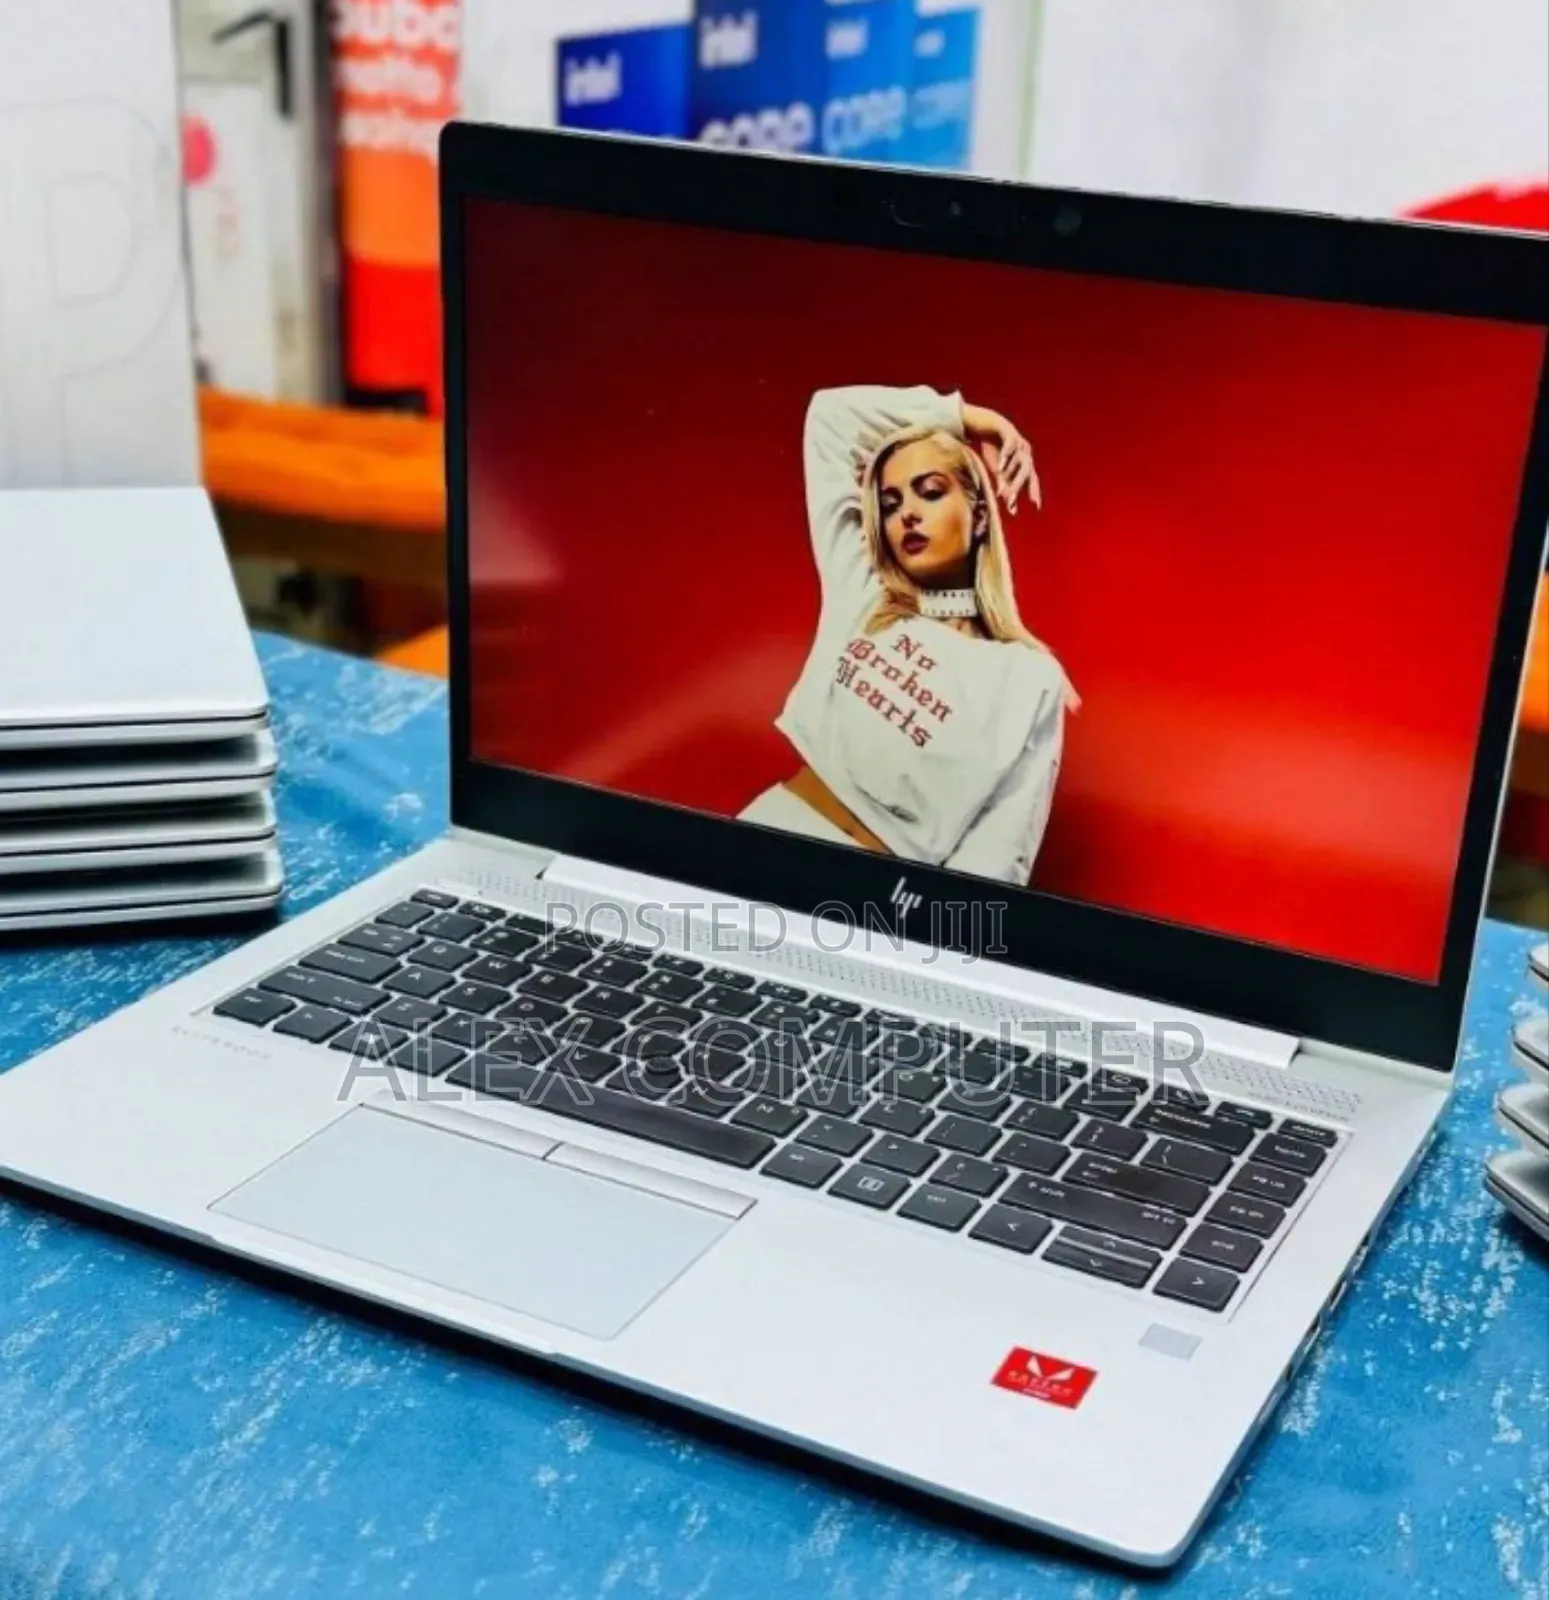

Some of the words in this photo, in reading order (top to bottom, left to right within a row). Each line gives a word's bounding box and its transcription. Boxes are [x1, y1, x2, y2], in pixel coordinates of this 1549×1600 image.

[847, 638, 953, 722] Broken
[891, 634, 937, 670] No
[836, 656, 932, 748] Hearts
[890, 876, 922, 919] hp
